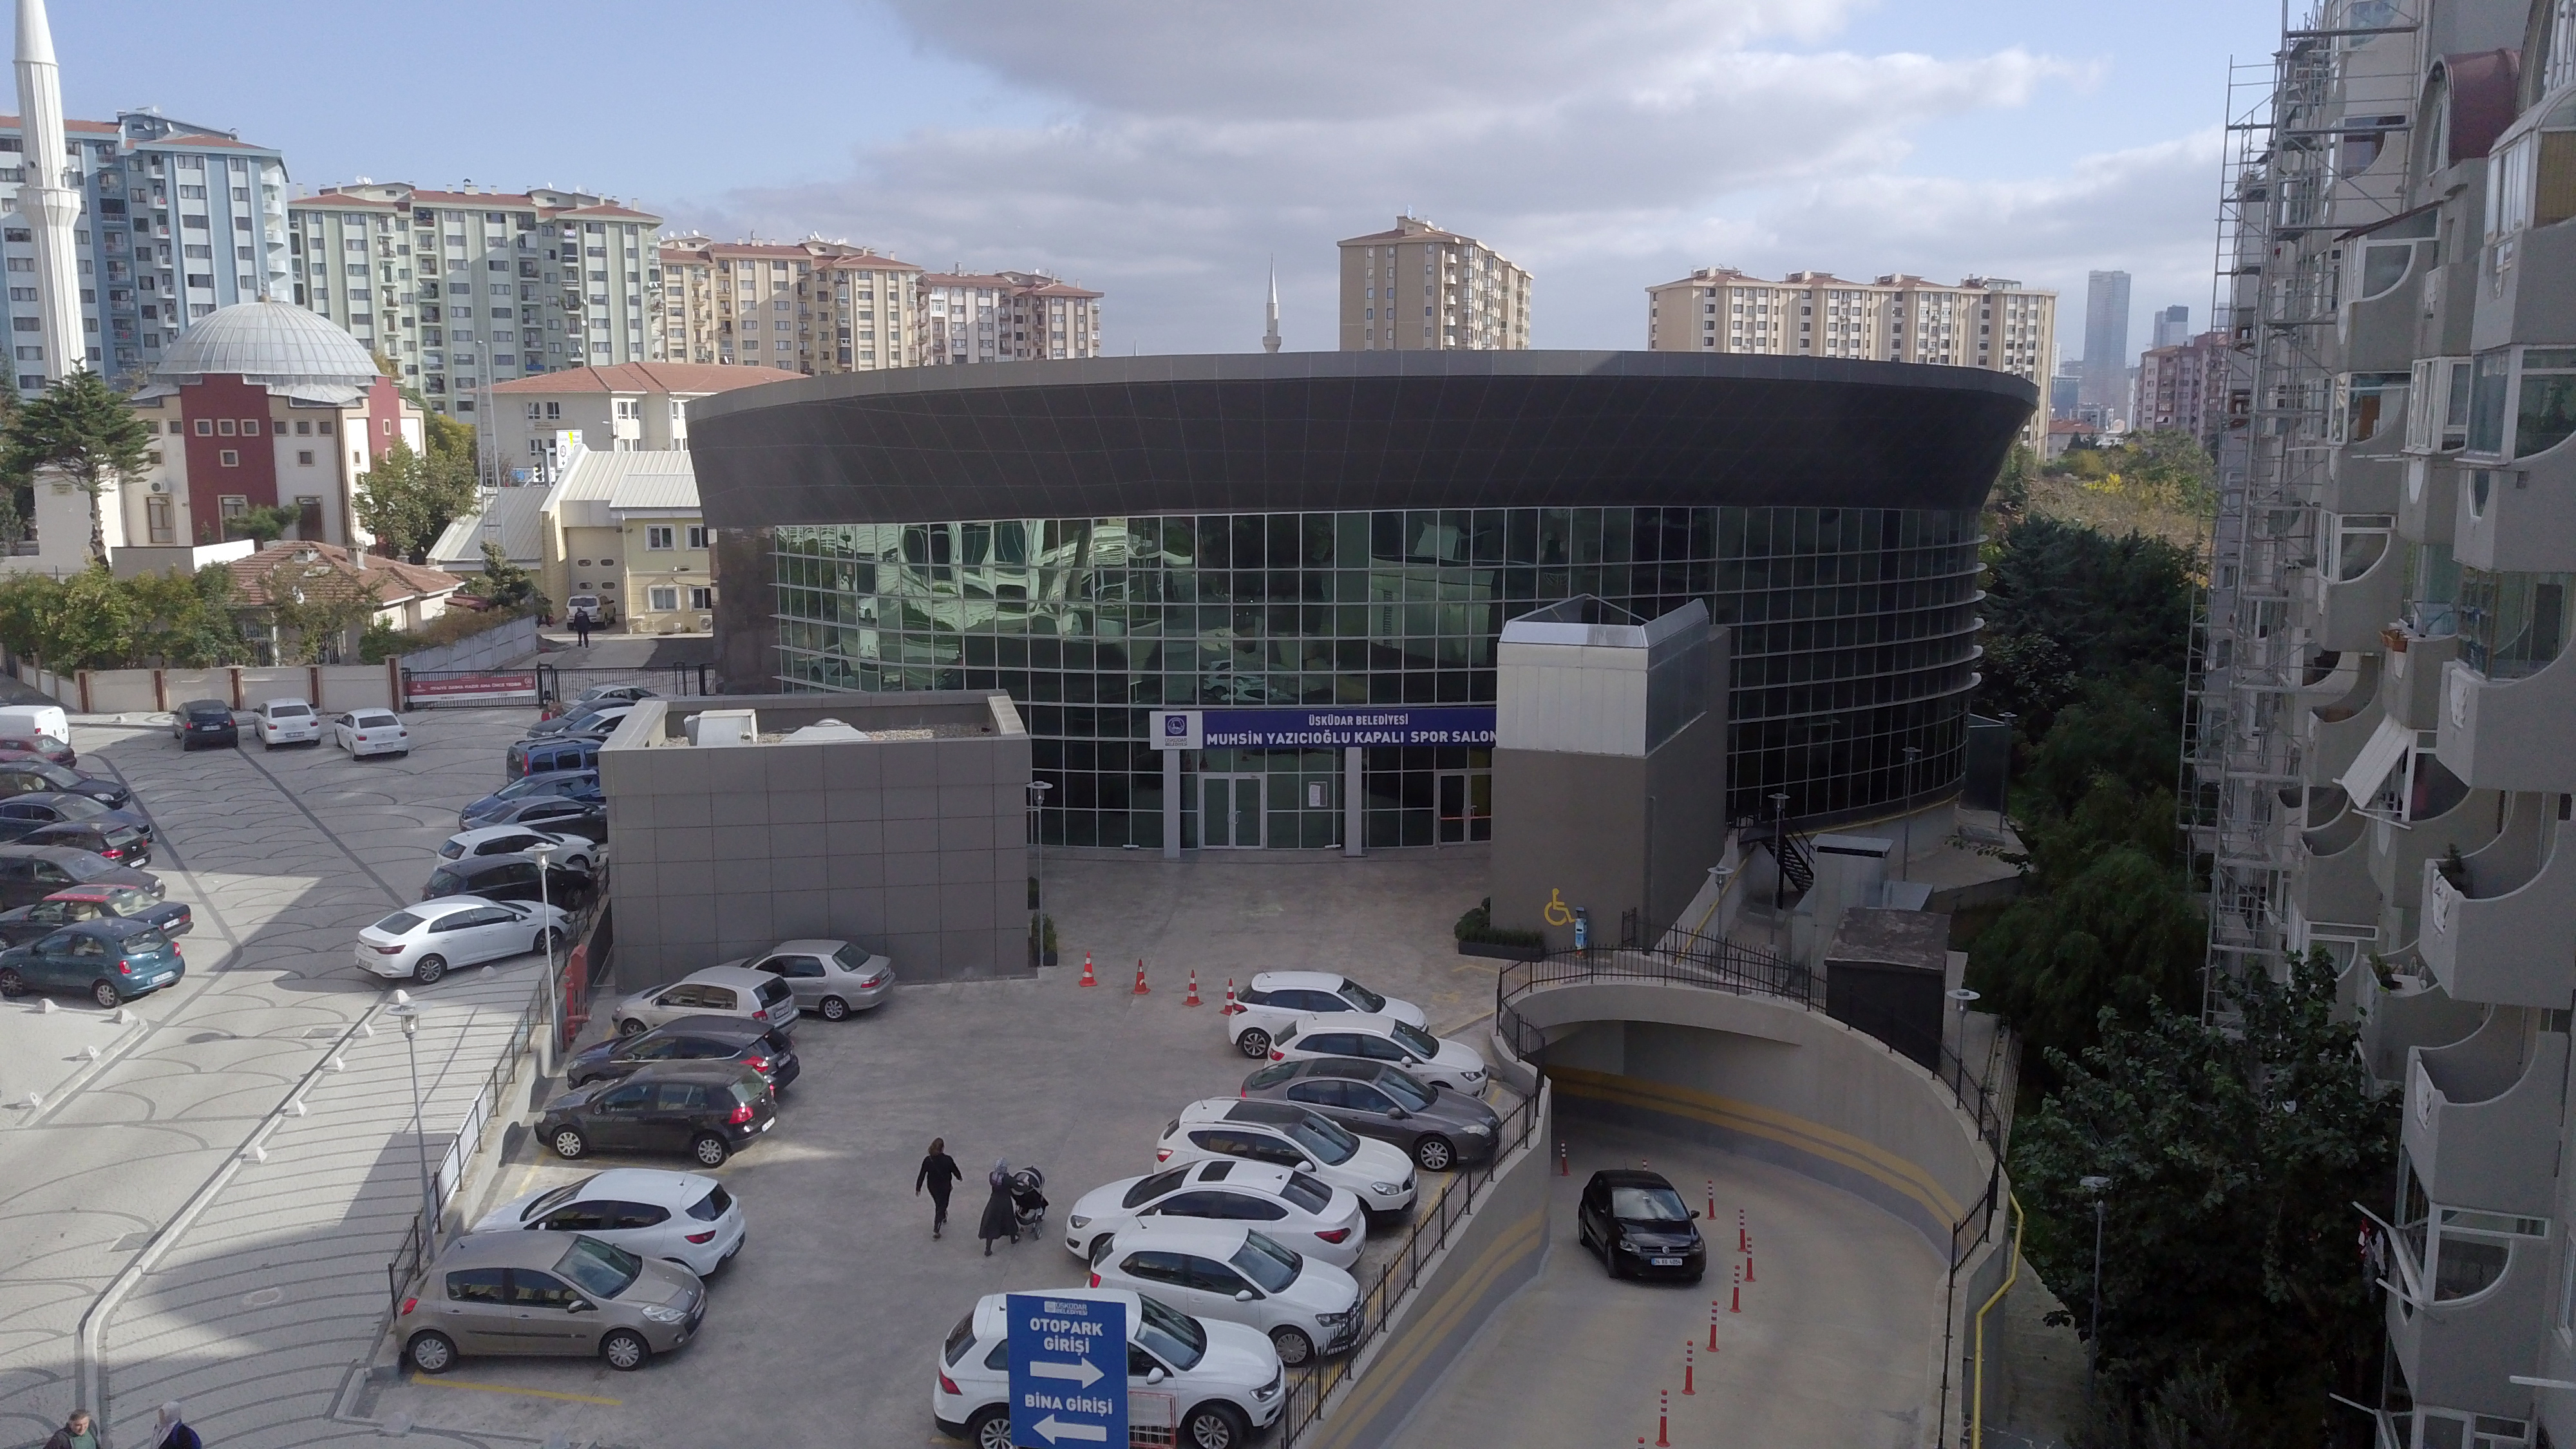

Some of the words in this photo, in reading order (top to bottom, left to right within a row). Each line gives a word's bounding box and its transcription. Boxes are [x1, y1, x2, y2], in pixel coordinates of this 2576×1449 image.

[1309, 714, 1354, 726] ÜSKÜDAR
[1356, 713, 1408, 725] BELEDİYESİ
[1206, 730, 1263, 745] MUHSİN
[1266, 729, 1350, 744] YAZICIOĞLU
[1354, 731, 1405, 743] KAPALI
[1410, 730, 1448, 743] SPOR
[1030, 1317, 1103, 1336] OTOPARK
[1044, 1335, 1090, 1356] GİRİŞİ
[1025, 1392, 1063, 1410] BİNA
[1066, 1394, 1113, 1417] GİRİŞİ
